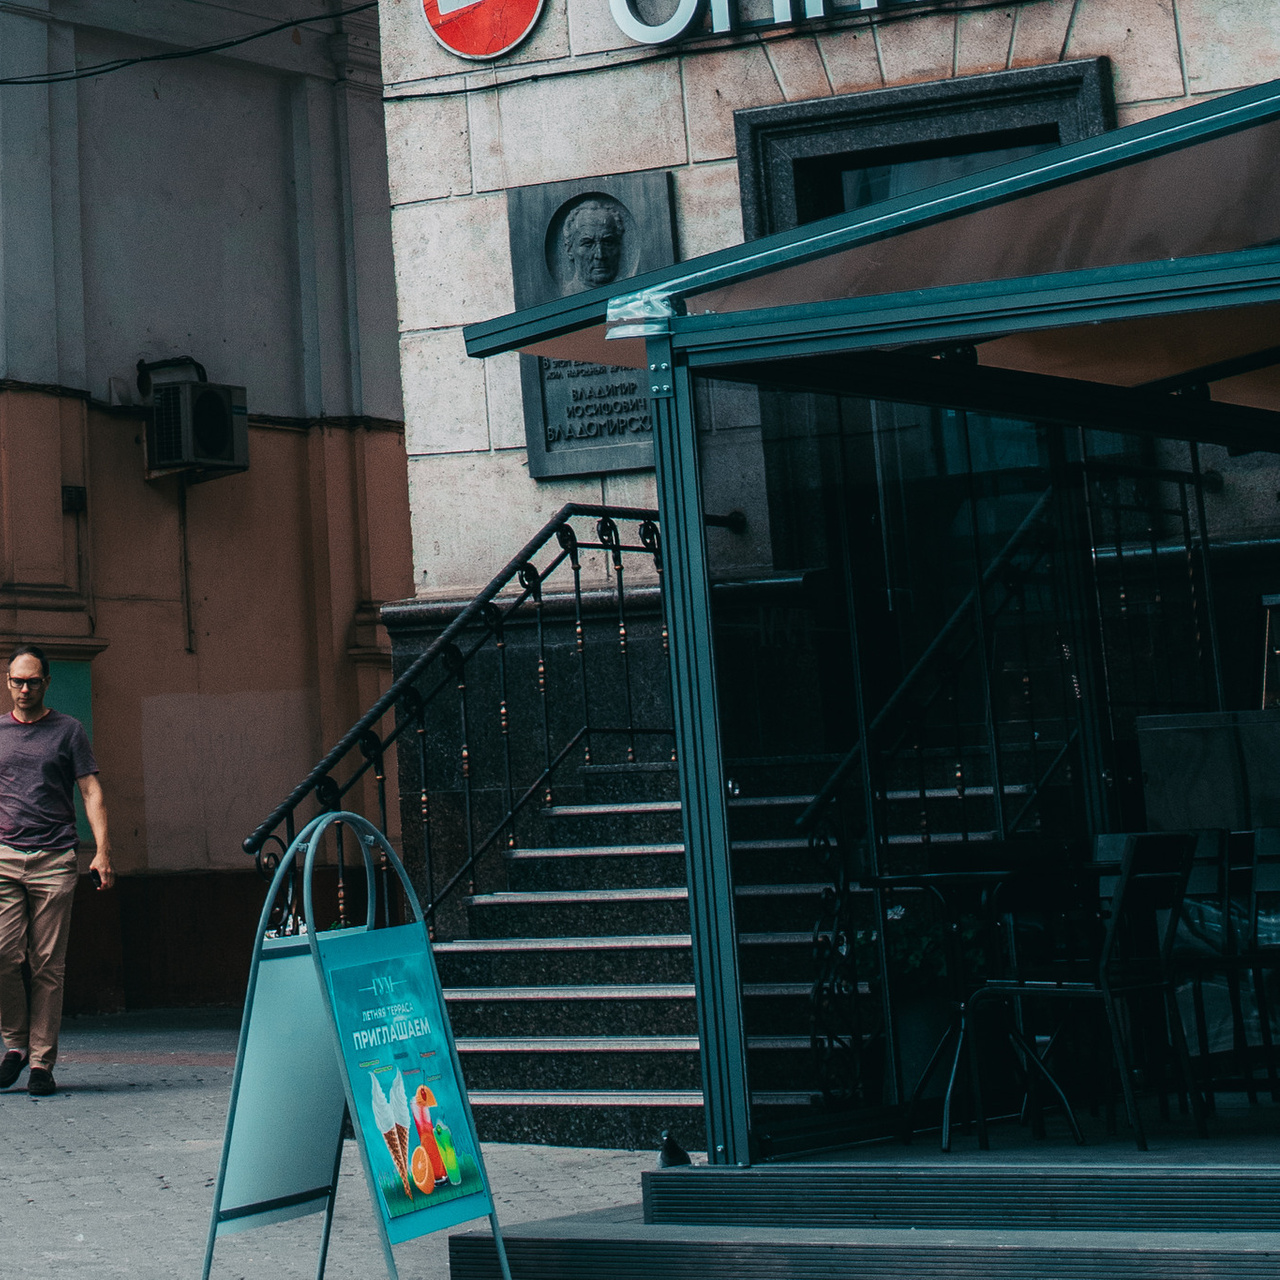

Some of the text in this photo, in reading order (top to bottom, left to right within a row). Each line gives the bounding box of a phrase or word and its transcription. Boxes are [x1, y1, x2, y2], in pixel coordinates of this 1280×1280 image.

[571, 382, 637, 401] ВЛАДИМИР
[566, 397, 647, 418] ИОСИФОВИЧ
[362, 1002, 414, 1022] ЛЕТНЯЯ ТЕРРАСА
[352, 1016, 432, 1051] ПРИГЛАШАЕМ
